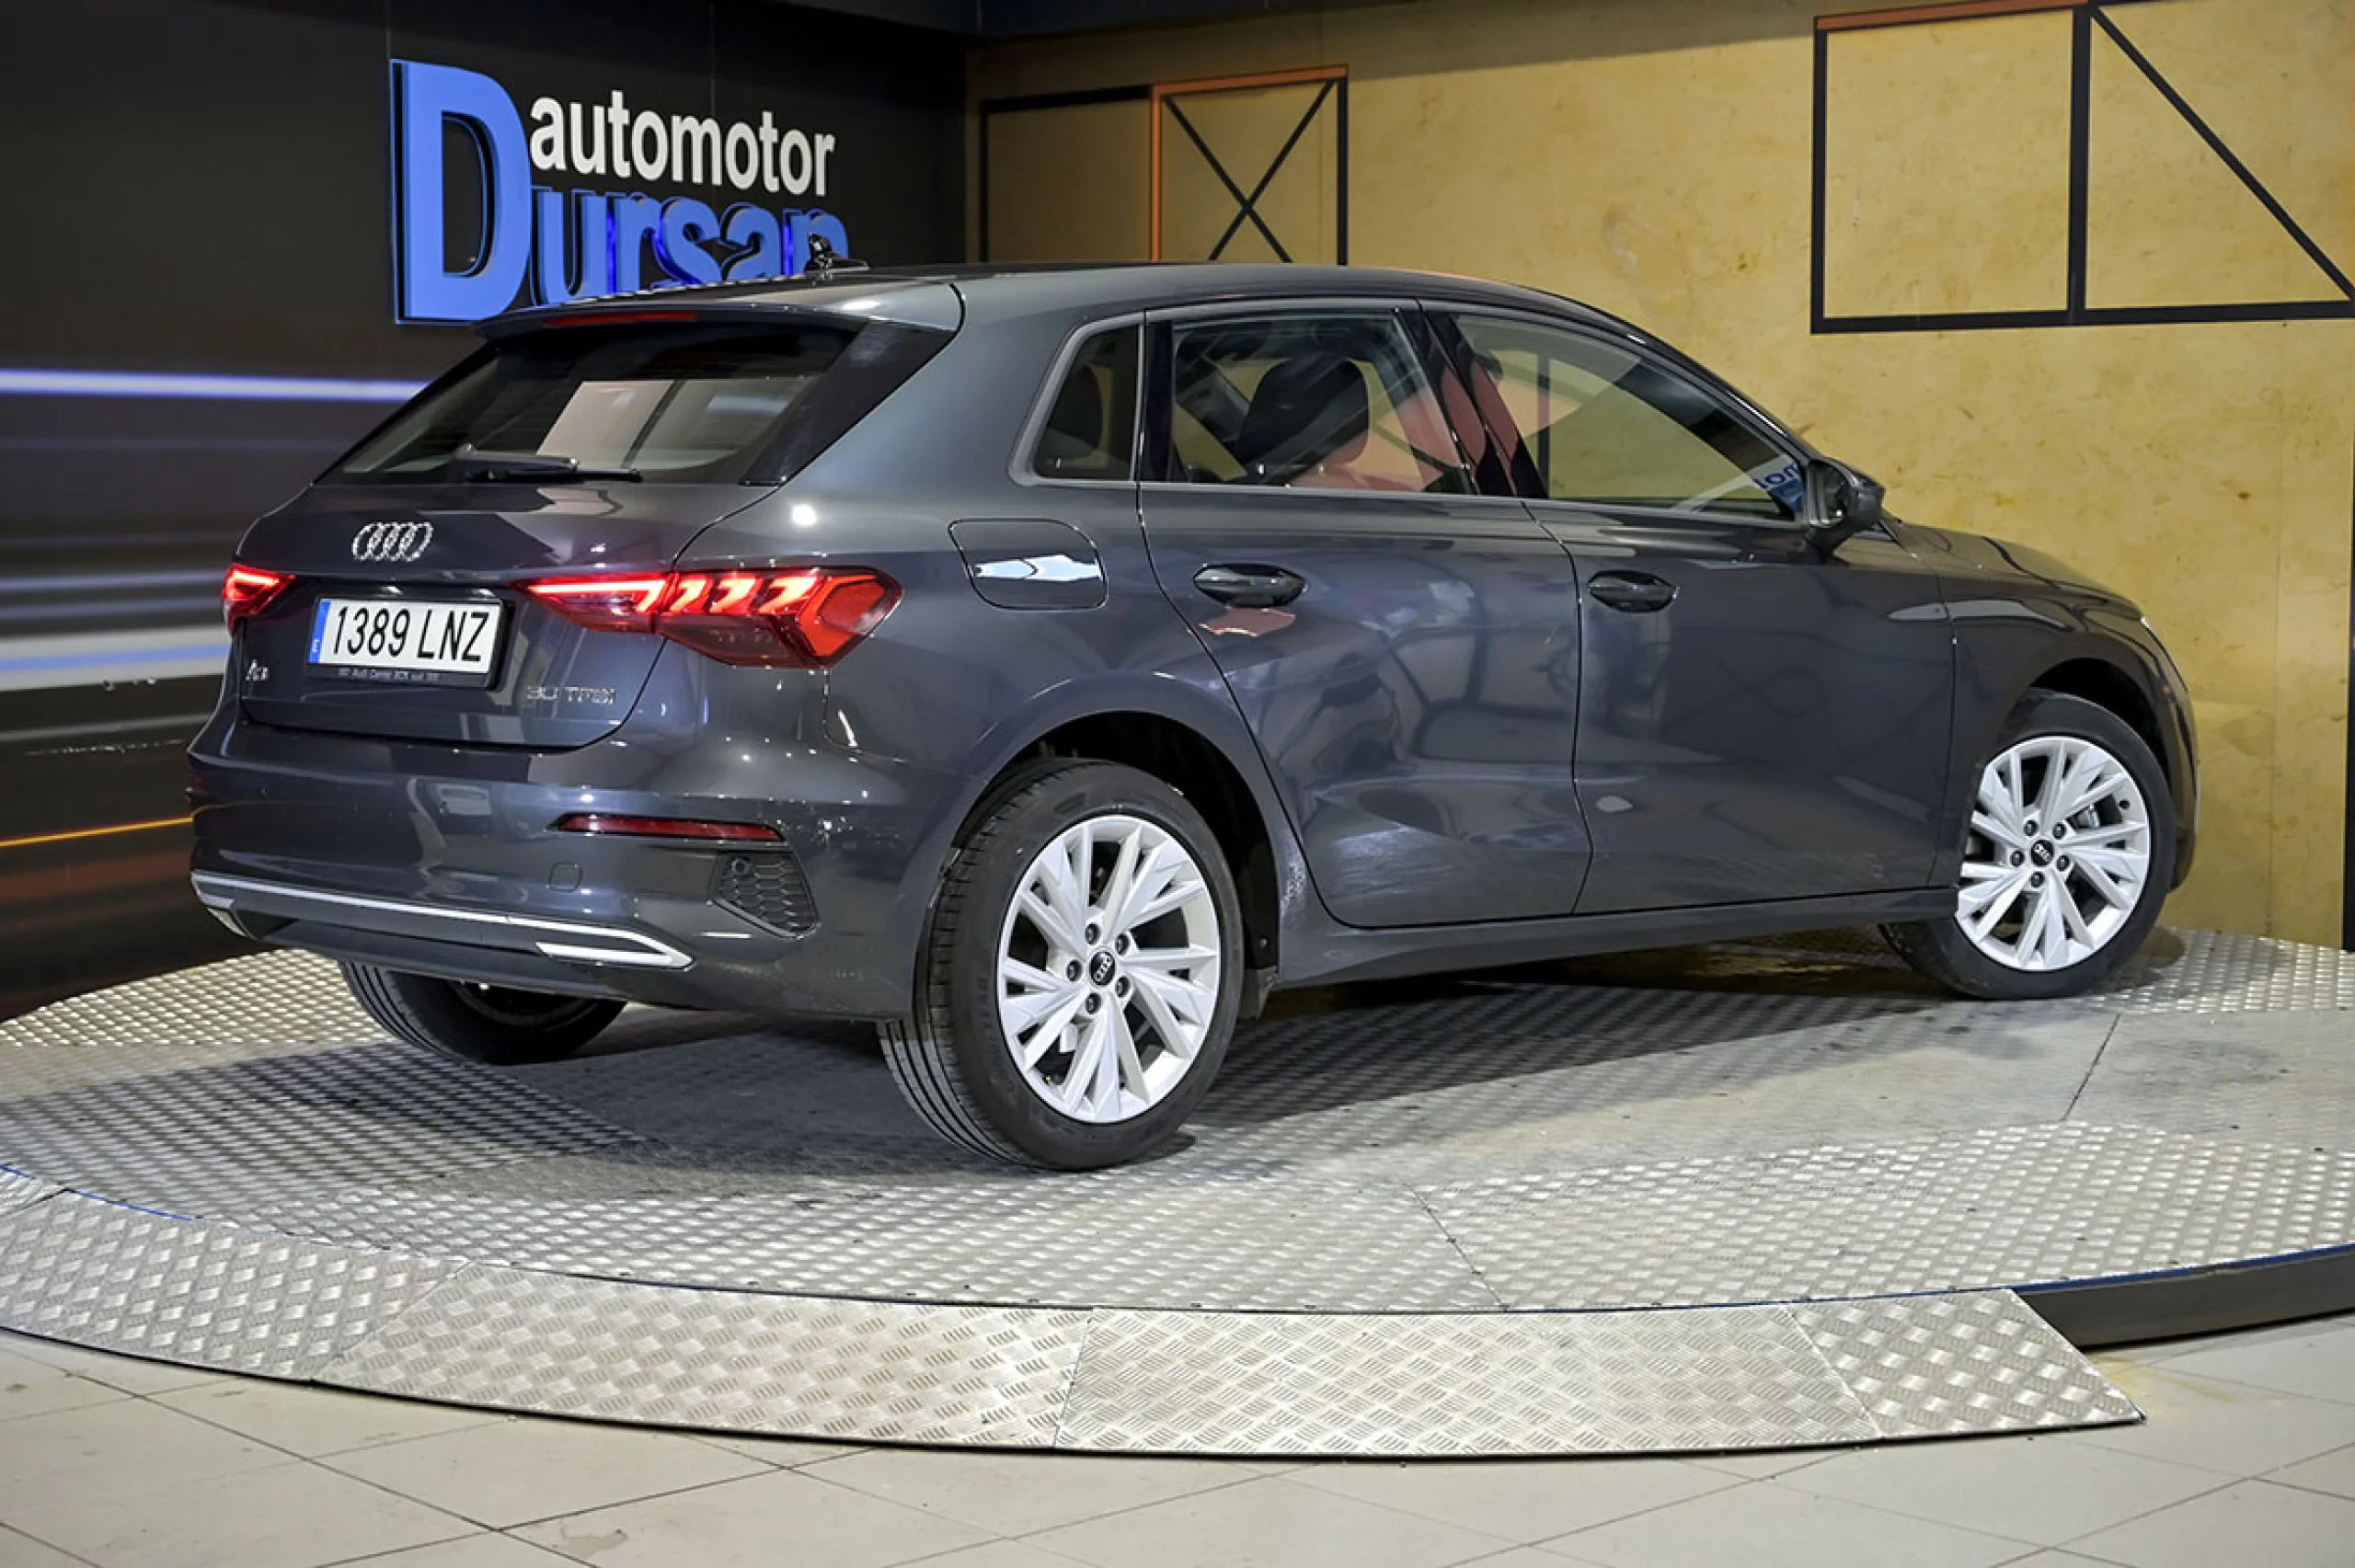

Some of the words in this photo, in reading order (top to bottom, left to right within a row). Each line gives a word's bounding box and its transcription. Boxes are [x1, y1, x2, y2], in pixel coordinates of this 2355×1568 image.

[390, 59, 849, 324] Dursan
[530, 90, 835, 196] automotor
[333, 606, 411, 658] 1389
[416, 610, 489, 662] LNZ
